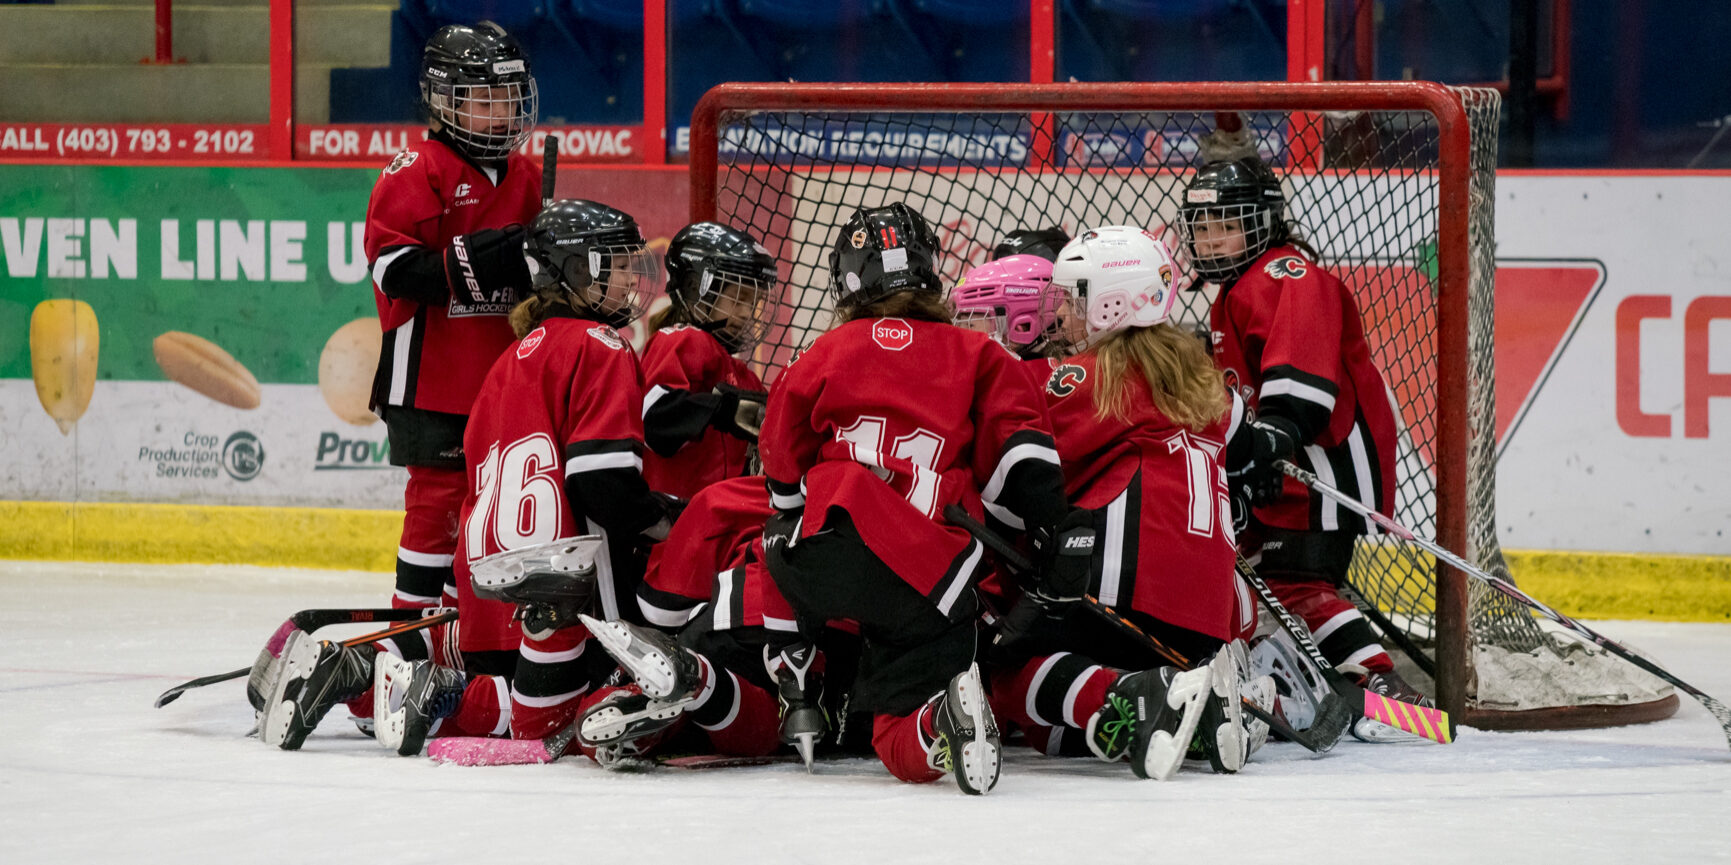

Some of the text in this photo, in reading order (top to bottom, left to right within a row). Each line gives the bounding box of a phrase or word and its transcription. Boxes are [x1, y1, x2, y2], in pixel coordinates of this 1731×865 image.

[428, 66, 448, 79] CCM
[57, 128, 118, 156] (403)
[126, 129, 171, 151] 793
[193, 130, 254, 153] 2102
[310, 130, 359, 155] FOR
[367, 130, 408, 155] ALL
[676, 126, 826, 155] EAVATION
[829, 129, 1027, 162] REQUIREMENTS
[555, 238, 584, 246] BAUER
[160, 218, 306, 283] LINE
[453, 234, 486, 302] BAUER
[1101, 259, 1141, 269] BAUER
[1005, 286, 1038, 294] BAUER
[451, 304, 475, 314] GIRLS
[877, 327, 908, 340] STOP
[520, 335, 541, 350] STOP
[183, 431, 218, 446] Crop
[138, 447, 218, 464] Production
[156, 464, 218, 479] Services
[836, 415, 945, 520] 11
[465, 431, 561, 564] 16
[1262, 540, 1283, 550] UER
